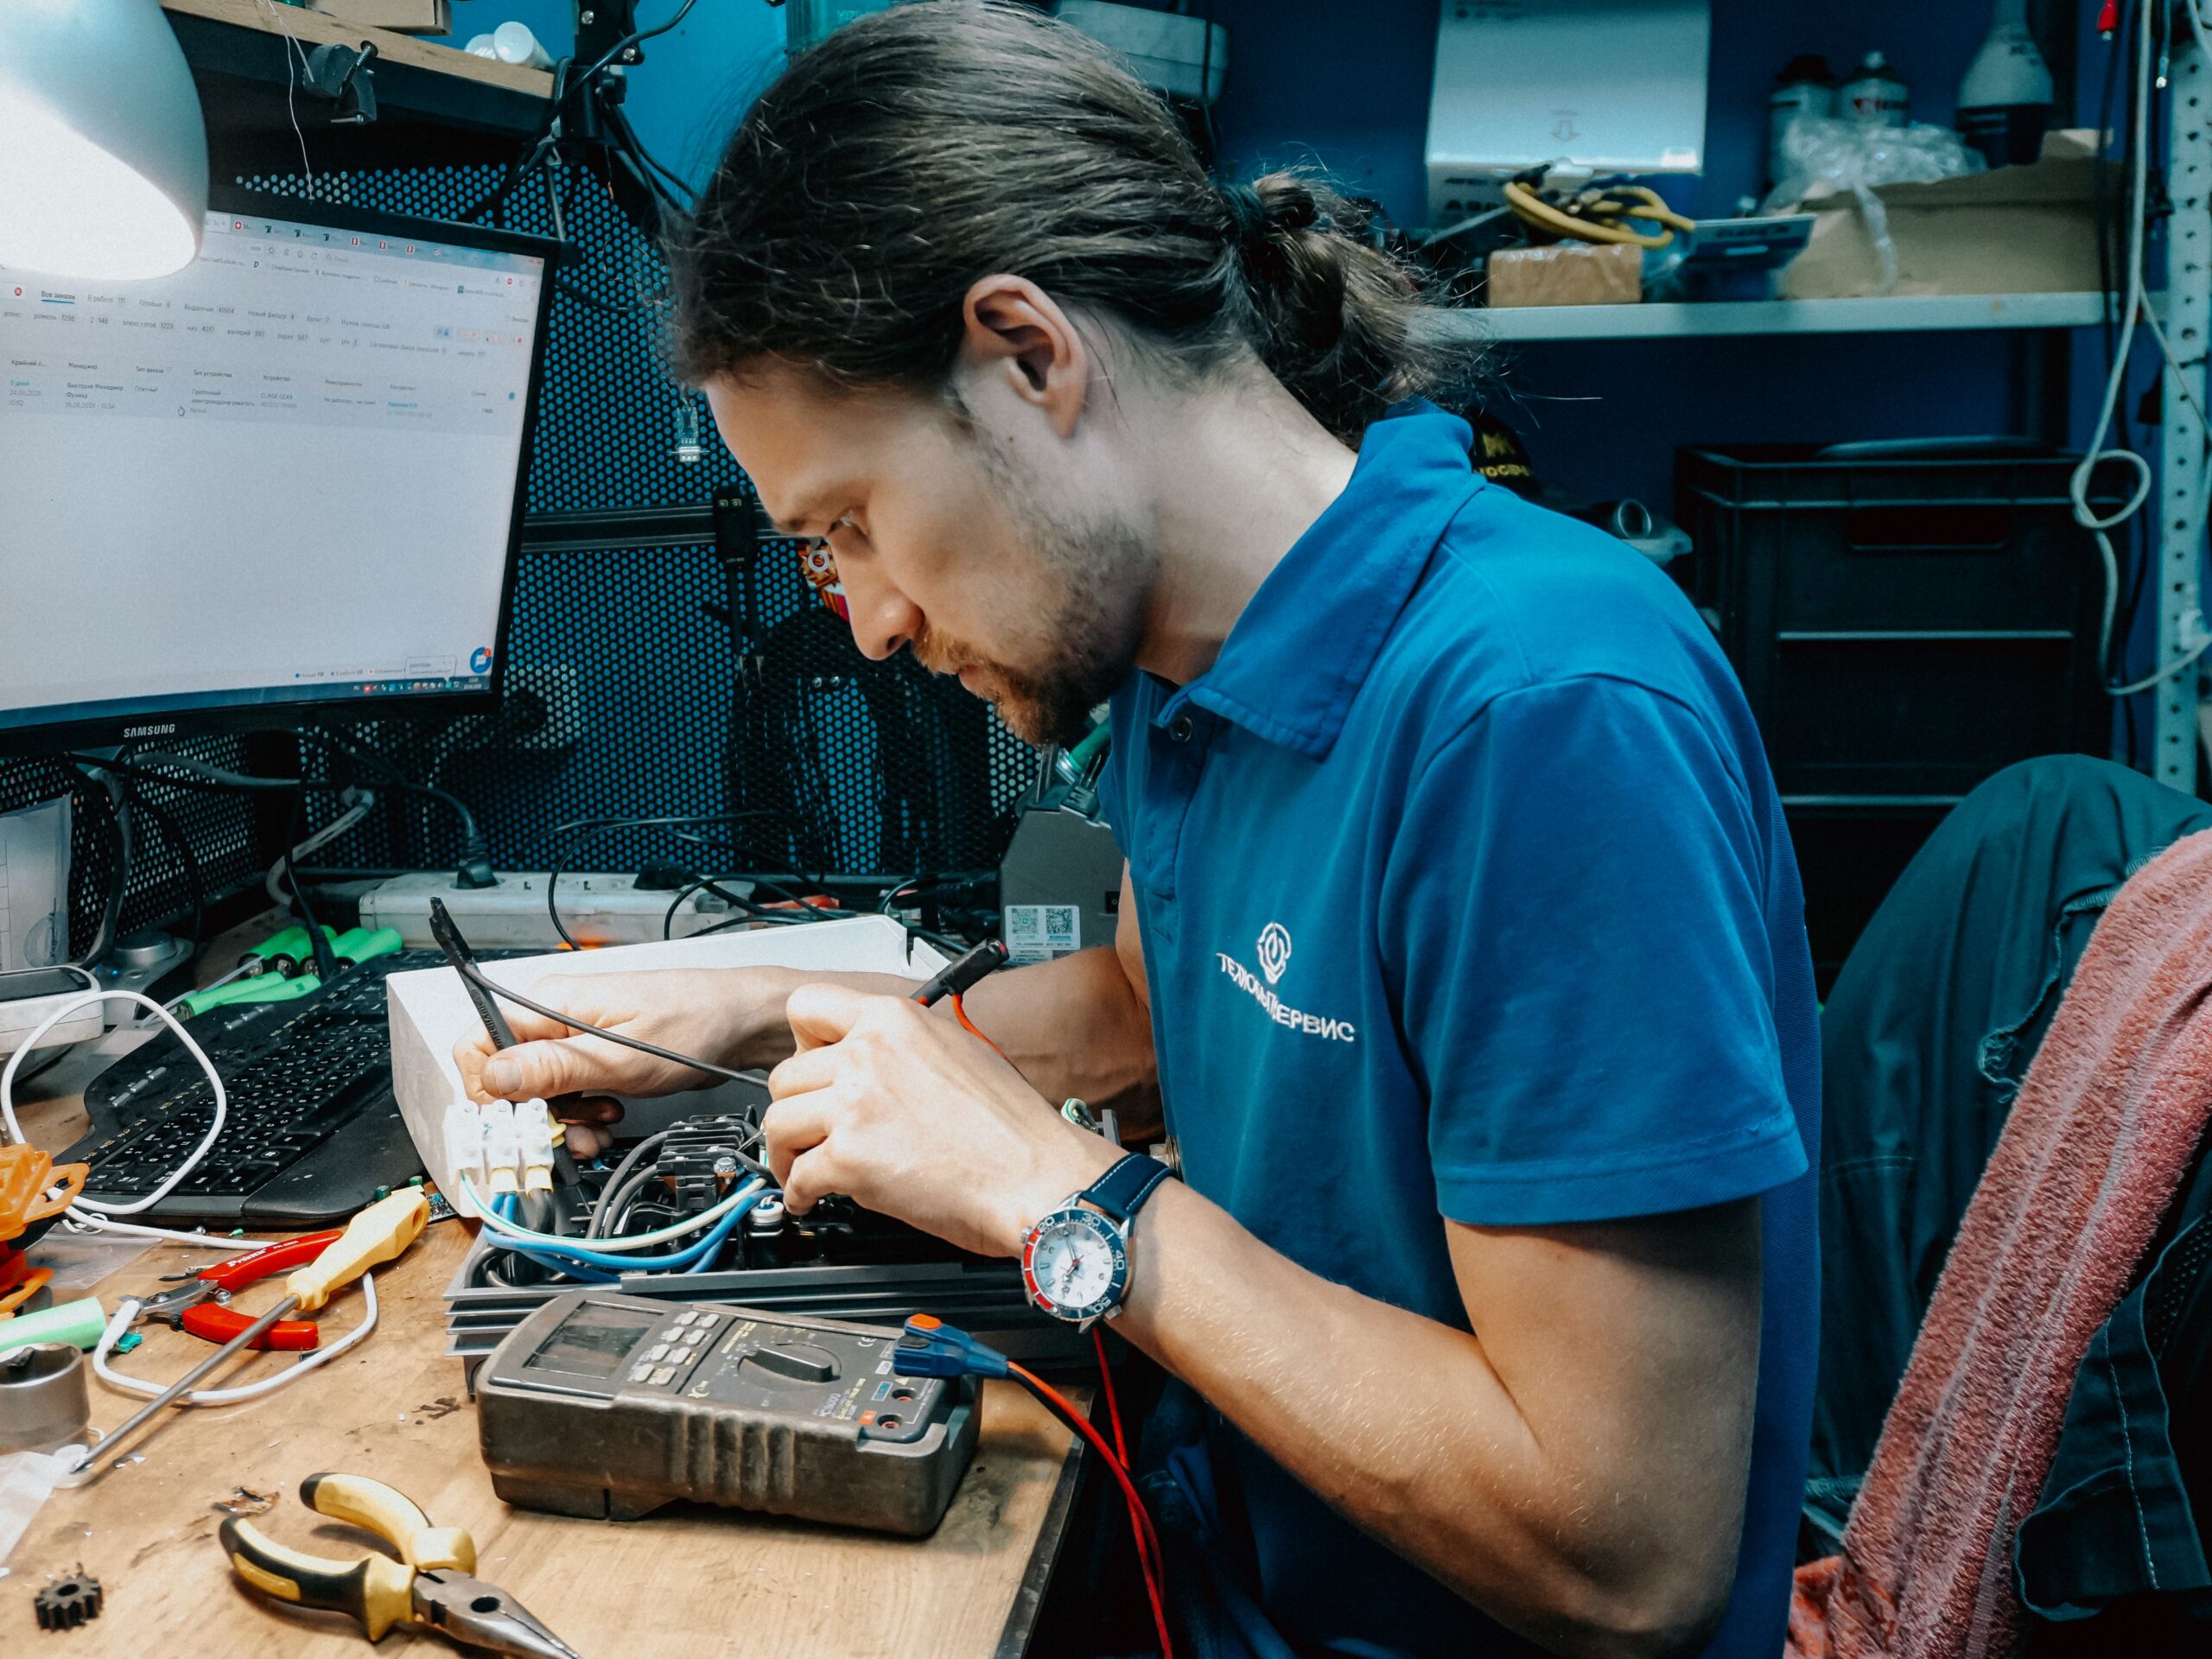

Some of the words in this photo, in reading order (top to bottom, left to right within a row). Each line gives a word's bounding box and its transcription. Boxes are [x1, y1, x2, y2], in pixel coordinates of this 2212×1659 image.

[124, 723, 175, 738] SAMSUNG
[1082, 1212, 1102, 1227] 30
[1116, 1249, 1125, 1271] 40
[1092, 1297, 1112, 1313] 50
